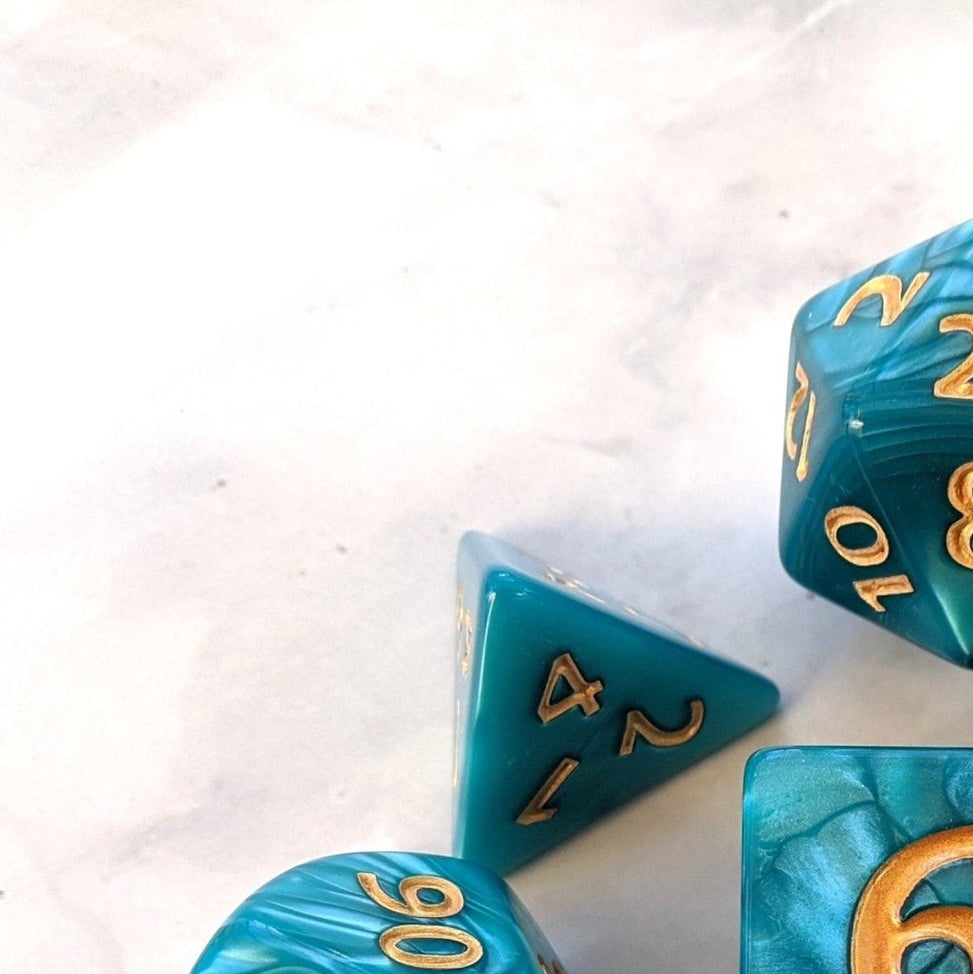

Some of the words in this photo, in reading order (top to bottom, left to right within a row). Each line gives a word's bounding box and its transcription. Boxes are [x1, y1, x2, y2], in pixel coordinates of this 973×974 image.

[834, 272, 931, 327] 2
[825, 505, 914, 613] 10
[537, 652, 604, 724] 4
[620, 701, 704, 755] 2
